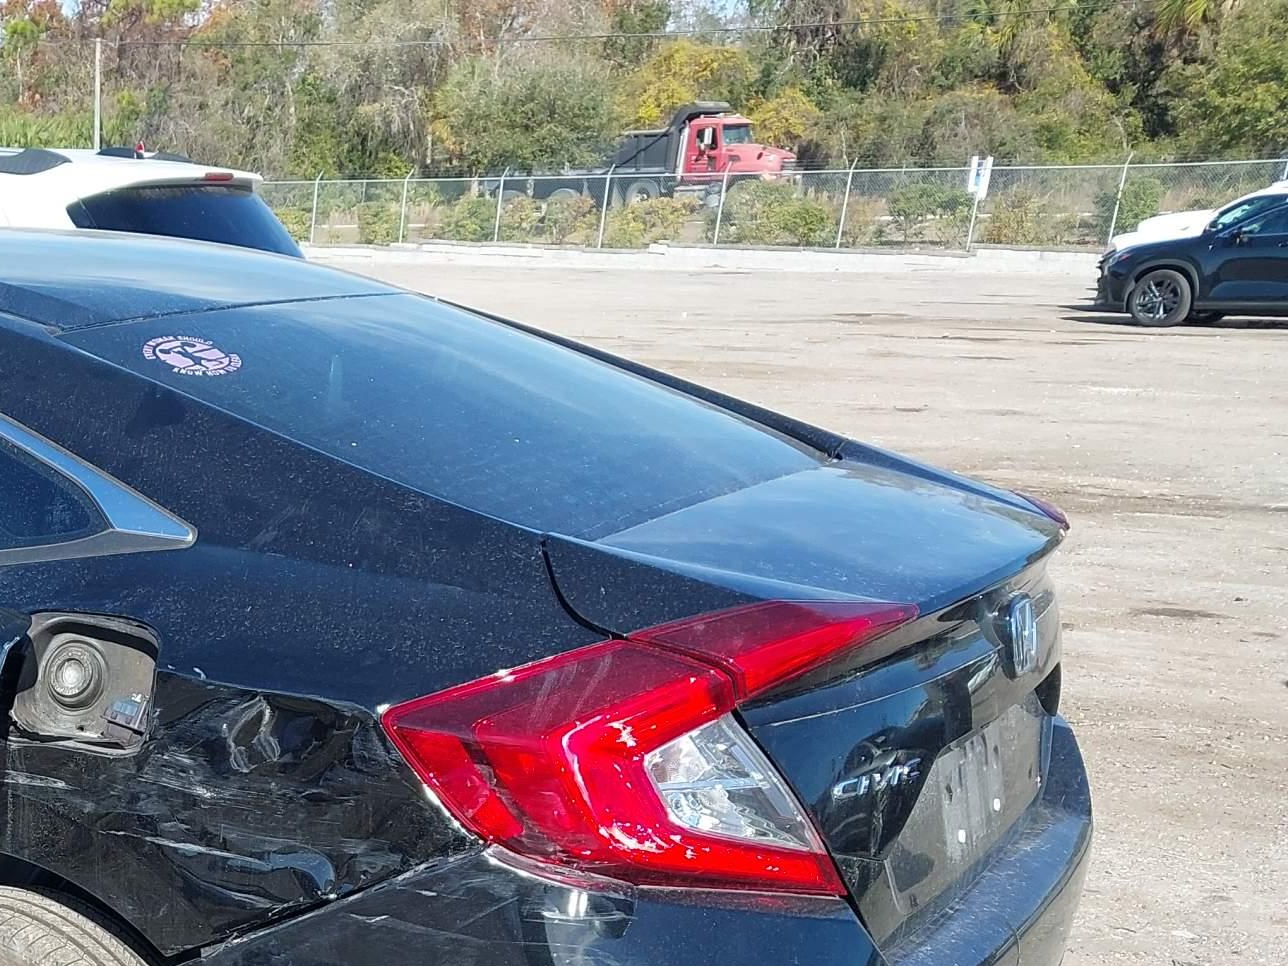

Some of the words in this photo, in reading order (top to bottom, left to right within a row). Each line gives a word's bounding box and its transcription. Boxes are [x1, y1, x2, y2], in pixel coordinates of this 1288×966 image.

[176, 335, 214, 346] SHOULD
[172, 366, 204, 377] KNOW
[831, 757, 922, 799] CIVIC
